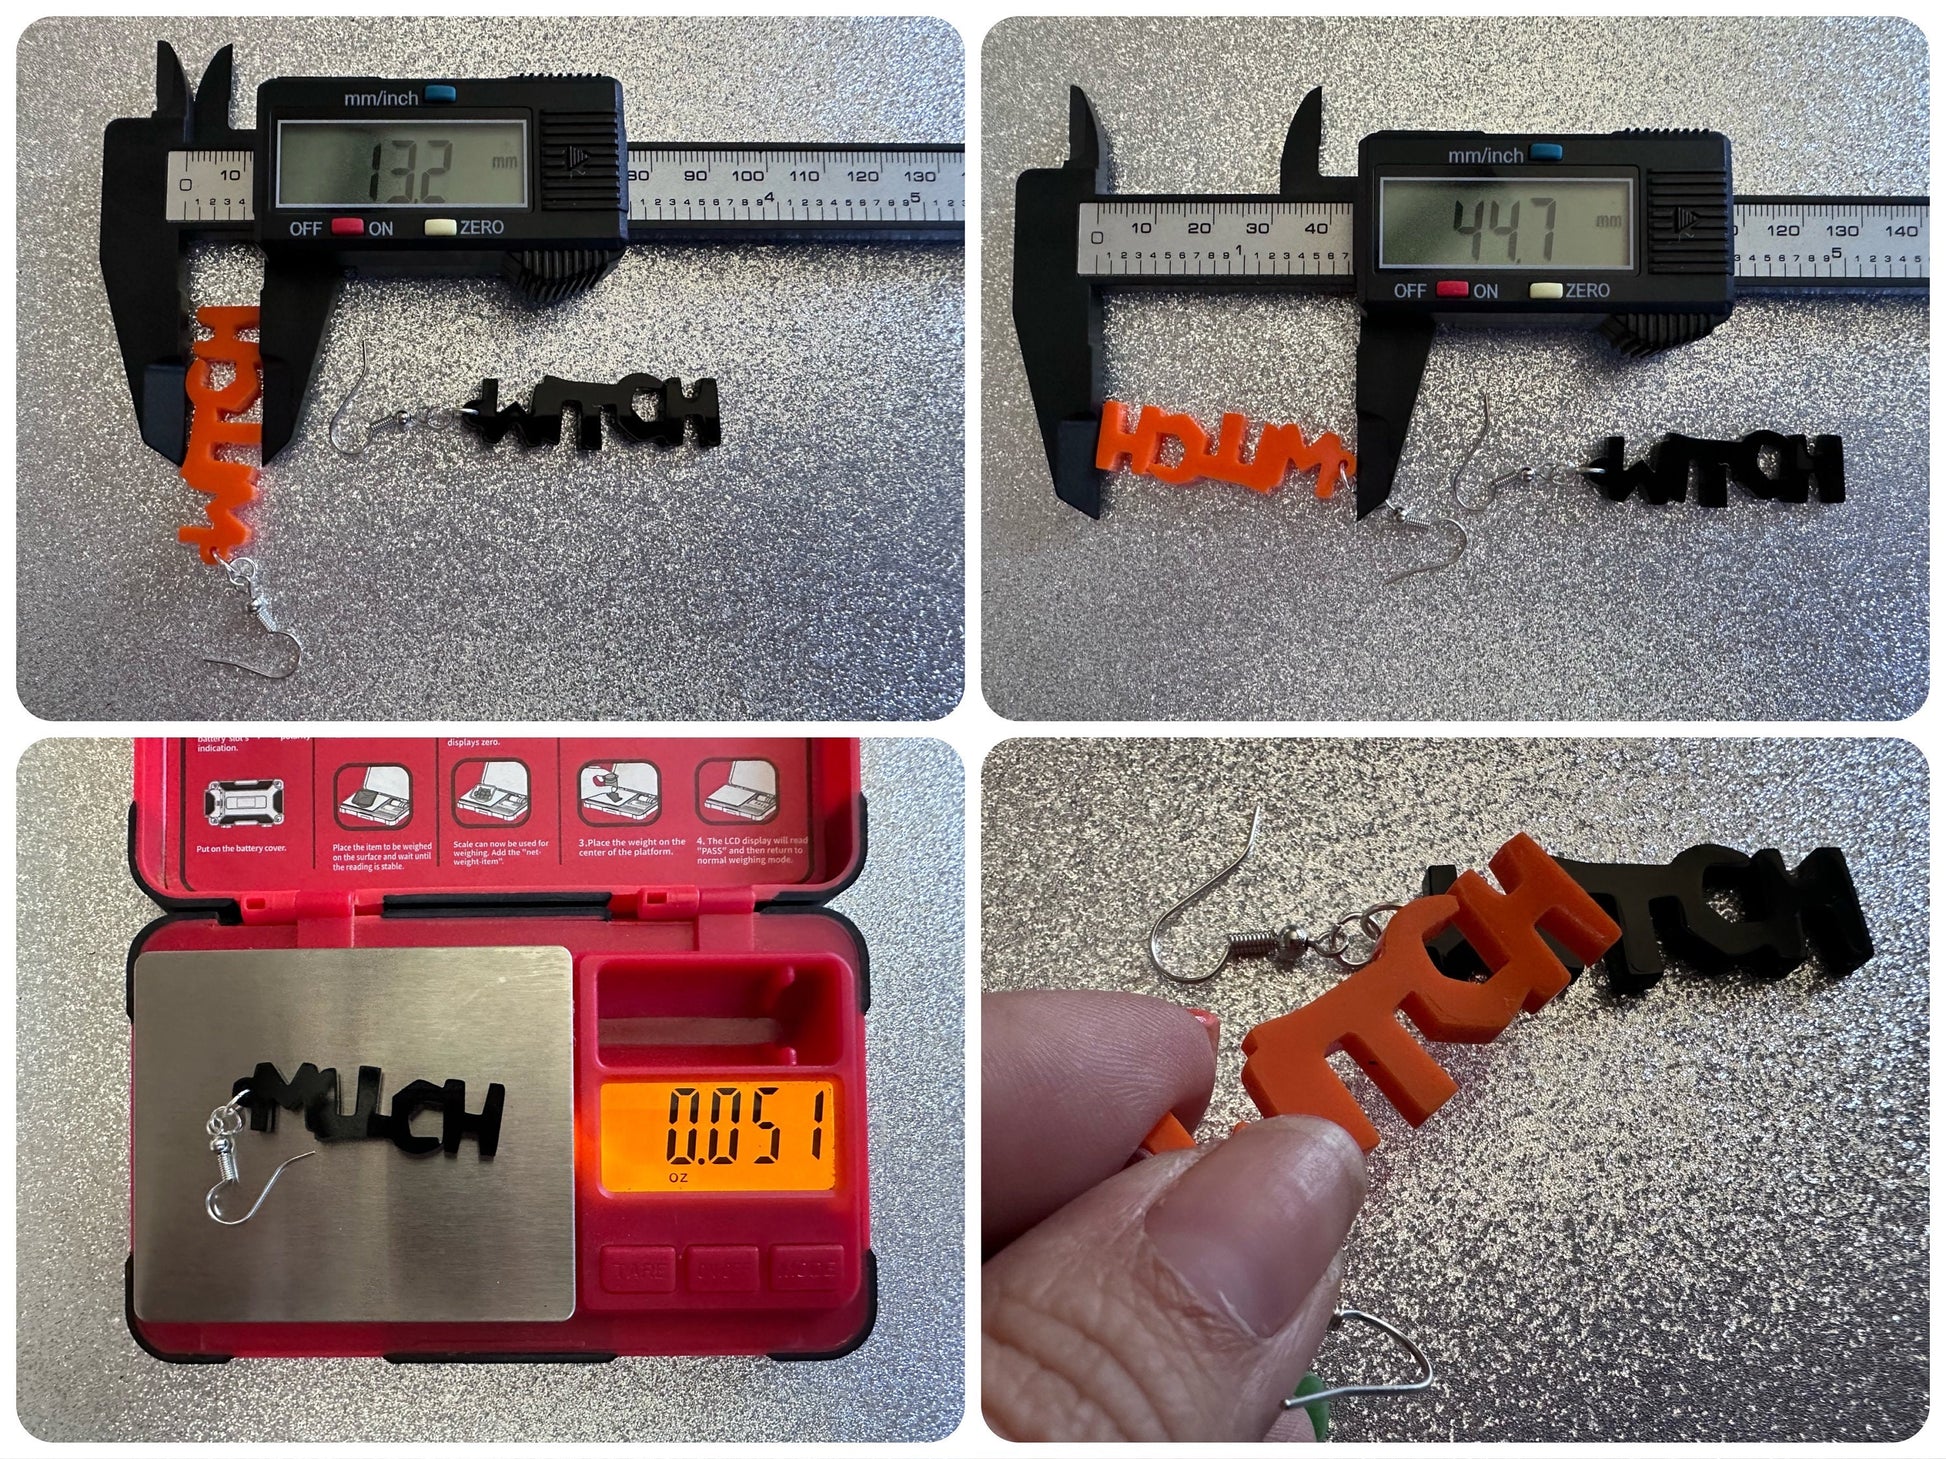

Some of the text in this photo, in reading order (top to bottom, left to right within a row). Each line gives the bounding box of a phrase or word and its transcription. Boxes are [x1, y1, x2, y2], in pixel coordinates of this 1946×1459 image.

[344, 90, 419, 107] mm/inch
[1449, 147, 1524, 165] mm/inch
[369, 140, 518, 204] 13.2 mm
[684, 170, 708, 181] 90
[732, 171, 765, 182] 100
[790, 171, 820, 182] 110
[847, 171, 879, 182] 120
[904, 171, 936, 182] 130
[180, 170, 241, 191] 0 10
[764, 192, 775, 202] 4
[910, 192, 921, 203] 5
[289, 220, 505, 236] OFF ON ZERO
[1091, 223, 1328, 244] 0 10 20 30 40
[1453, 198, 1622, 264] 44.7 mm
[1767, 225, 1919, 237] 120 130 140
[1236, 244, 1242, 255] 1
[1254, 252, 1259, 260] 1
[1269, 252, 1276, 260] 2
[1283, 252, 1290, 260] 3
[1298, 252, 1305, 260] 4
[1313, 252, 1320, 260] 5
[1327, 252, 1335, 260] 6
[1342, 252, 1349, 260] 7
[1832, 247, 1842, 259] 5
[1394, 283, 1611, 299] OFF ON ZERO
[464, 373, 721, 449] WITCH
[1588, 430, 1845, 507] WITCH
[447, 739, 480, 748] displays
[333, 842, 433, 852] Place the item to be weighed
[453, 840, 474, 848] Scale
[612, 838, 627, 846] the
[628, 838, 657, 847] weight
[672, 837, 686, 846] the
[696, 837, 706, 845] 4.
[707, 837, 723, 845] The
[724, 837, 741, 845] LCD
[742, 837, 772, 846] display
[197, 845, 209, 853] Put
[236, 845, 263, 853] battery
[453, 849, 490, 858] weighing.
[578, 848, 674, 857] center of the platform.
[728, 846, 745, 854] and
[746, 846, 766, 854] then
[766, 846, 793, 854] return
[794, 846, 803, 854] to
[343, 853, 355, 861] the
[356, 853, 382, 861] surface
[383, 852, 396, 860] and
[398, 852, 413, 860] wait
[415, 852, 432, 860] until
[697, 856, 793, 866] normal weighing mode.
[333, 862, 404, 872] the reading is stable.
[666, 1087, 824, 1166] 0.051
